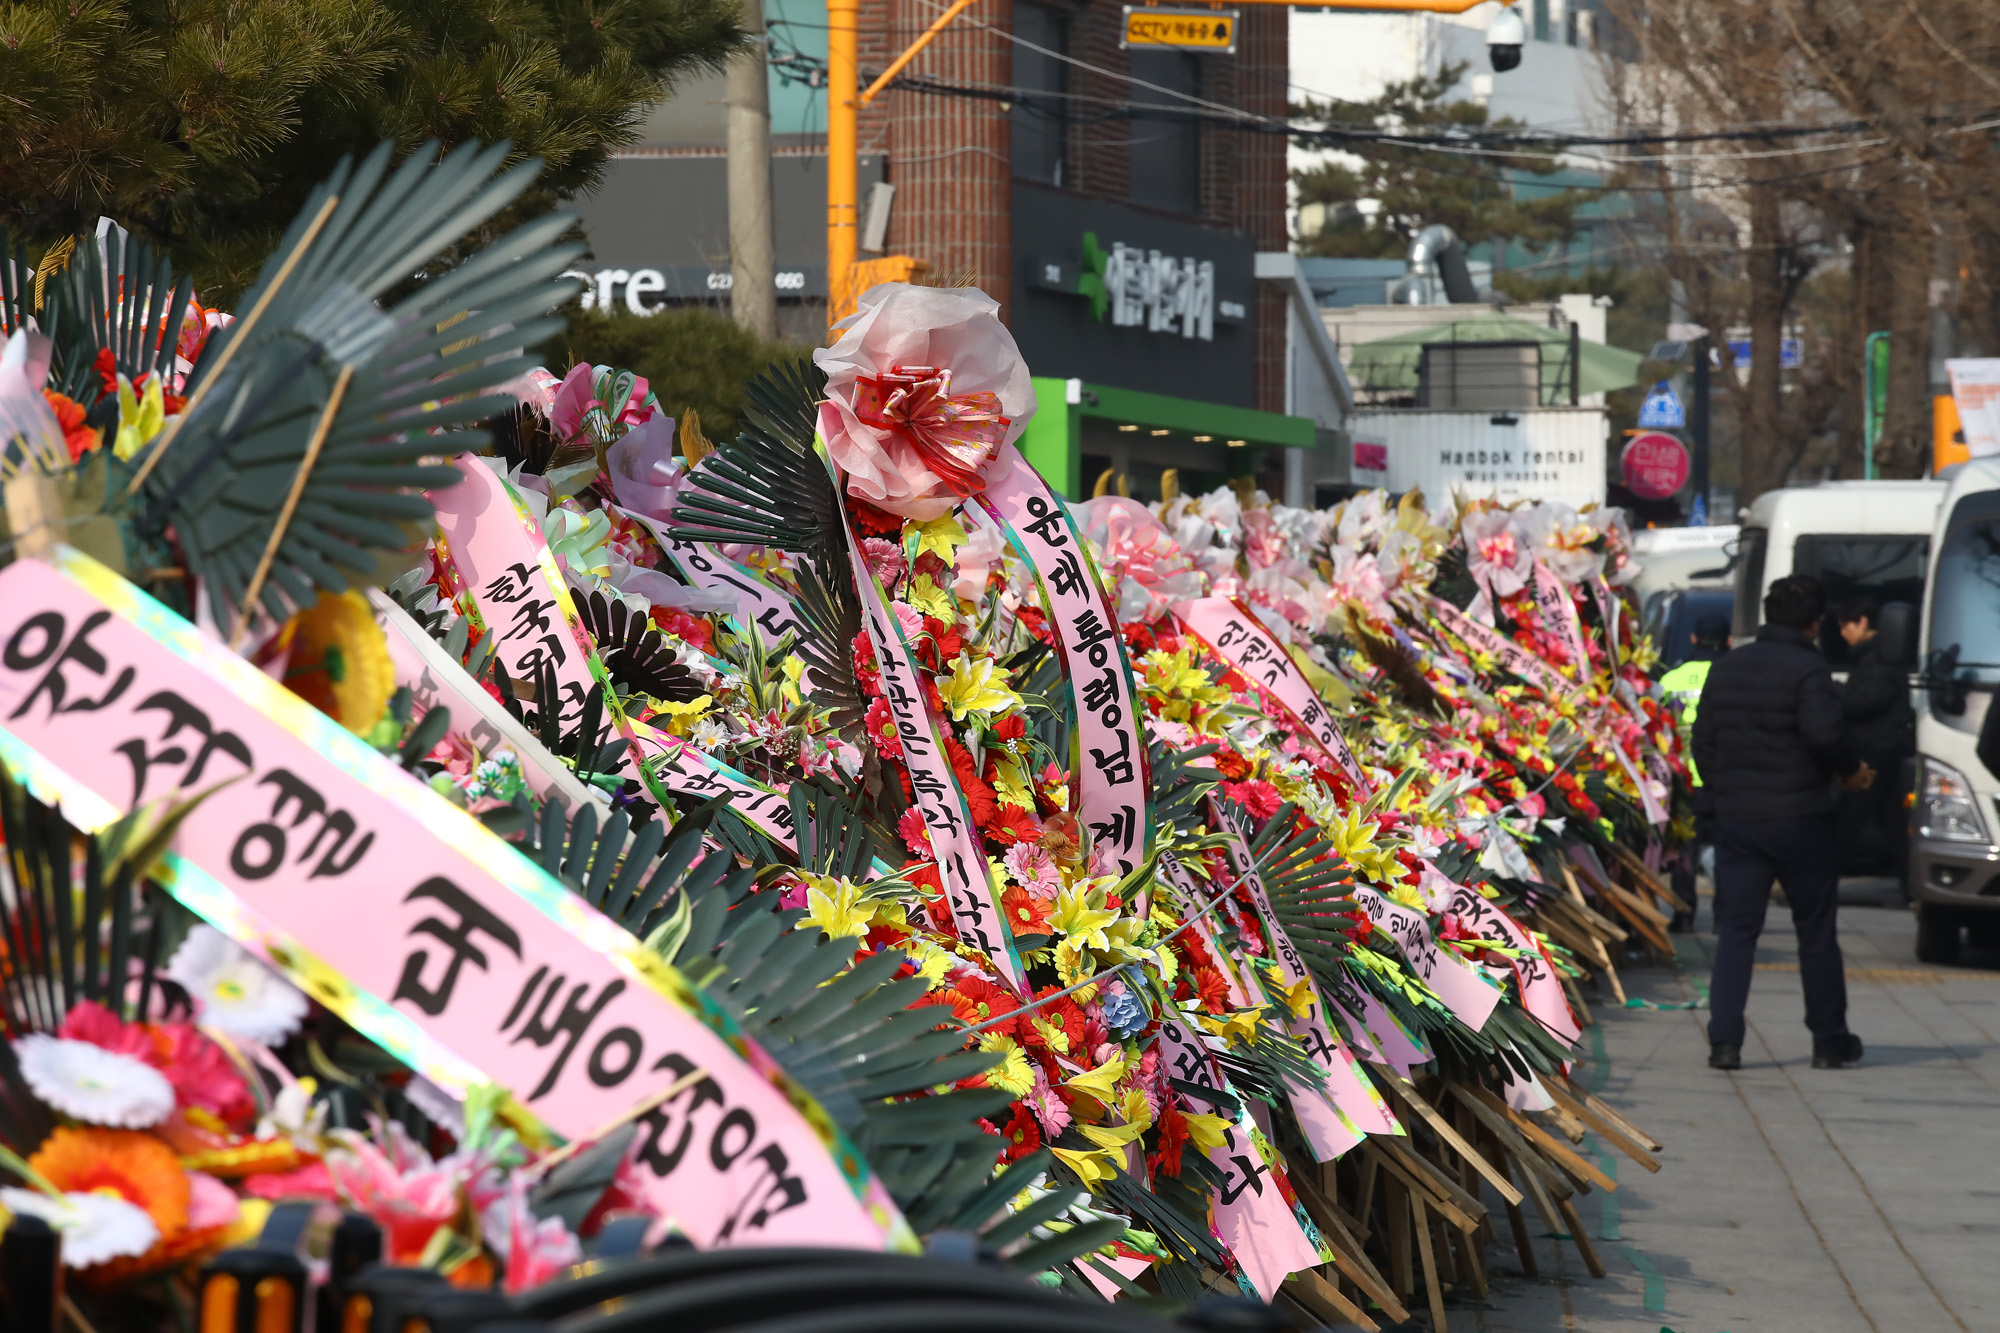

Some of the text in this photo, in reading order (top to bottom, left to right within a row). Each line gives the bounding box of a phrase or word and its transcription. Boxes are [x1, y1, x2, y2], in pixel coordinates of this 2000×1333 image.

[1129, 21, 1171, 36] CCTV
[1440, 450, 1585, 465] Hanbok rental
[1217, 618, 1290, 689] 언젠가
[2, 608, 379, 881] 윤석열
